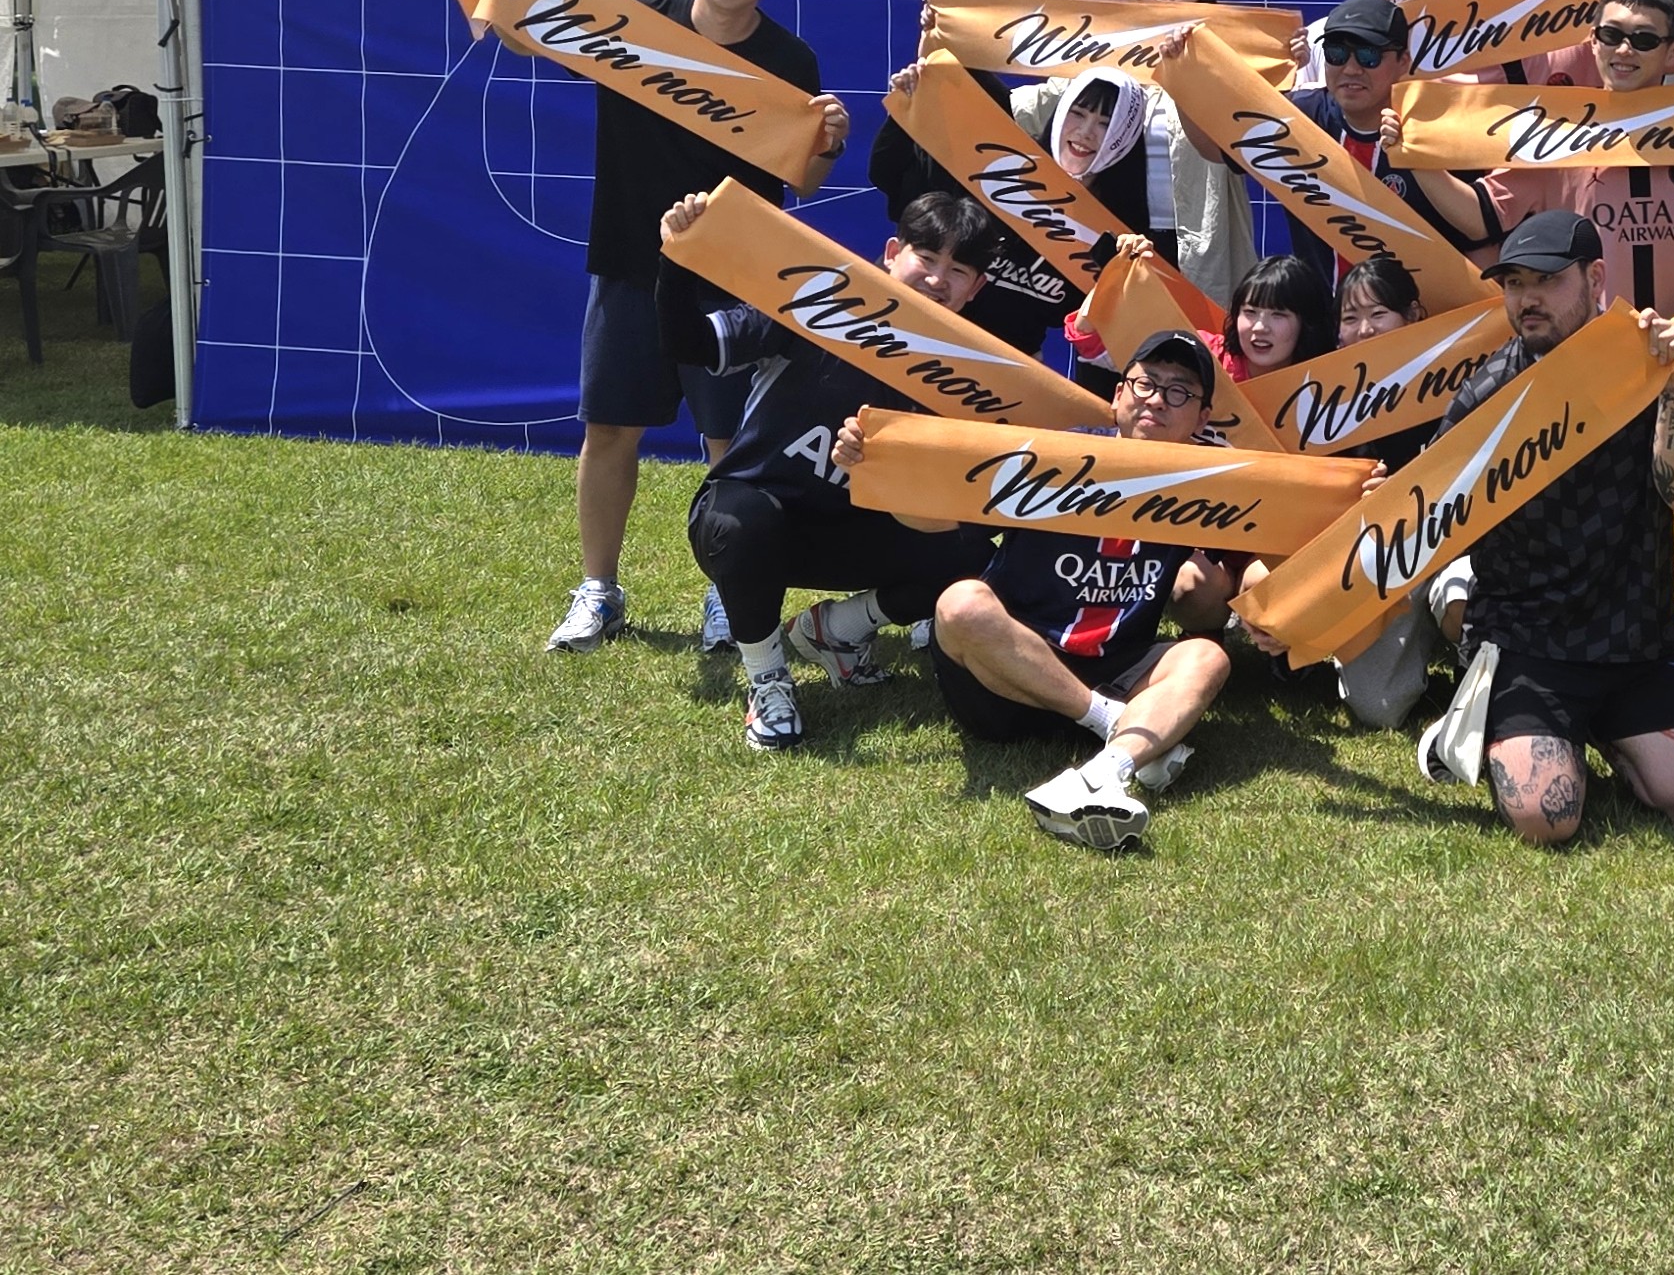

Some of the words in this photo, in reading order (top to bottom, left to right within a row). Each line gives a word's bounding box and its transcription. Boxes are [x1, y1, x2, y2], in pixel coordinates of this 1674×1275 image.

[994, 12, 1115, 66] Win
[1407, 1, 1514, 76] Win
[641, 70, 758, 134] now.
[1486, 102, 1632, 163] Win
[967, 142, 1077, 244] Win
[1230, 110, 1330, 207] Win
[777, 264, 909, 362] Win
[906, 353, 1023, 425] now.
[1274, 362, 1407, 451] Win
[965, 449, 1128, 518] Win
[1131, 491, 1263, 532] now.
[1341, 485, 1473, 601] Win
[1485, 401, 1586, 504] now.
[1054, 553, 1165, 587] QATAR
[1076, 584, 1156, 603] AIRWAYS
